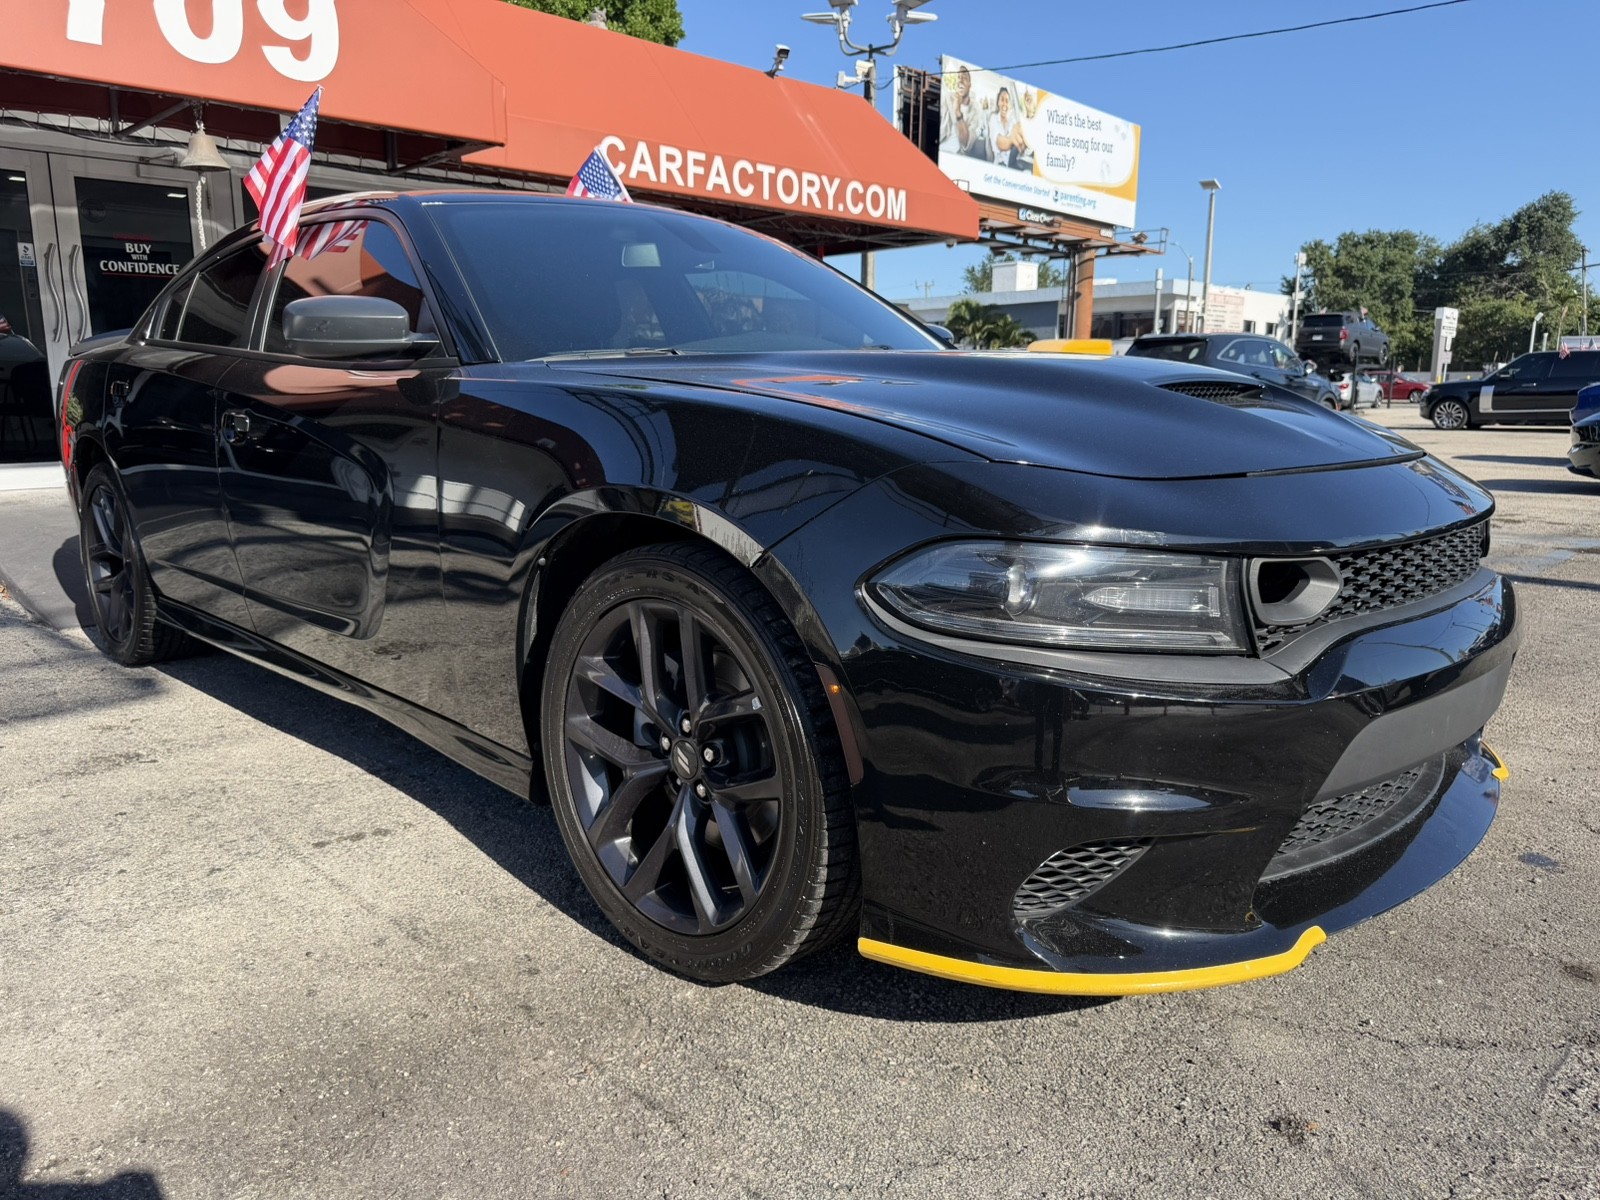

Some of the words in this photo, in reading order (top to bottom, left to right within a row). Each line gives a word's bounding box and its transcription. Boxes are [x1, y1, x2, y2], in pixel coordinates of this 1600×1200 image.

[1046, 109, 1073, 126] What's
[1074, 113, 1086, 129] the
[1086, 115, 1102, 131] best
[1046, 131, 1070, 148] theme
[1071, 137, 1089, 153] song
[1090, 137, 1101, 151] for
[1101, 142, 1113, 153] our
[1046, 152, 1076, 172] family?
[600, 135, 907, 222] CARFACTORY.COM
[984, 173, 993, 183] Get
[993, 174, 1001, 184] the
[1001, 178, 1033, 193] Conversation
[1033, 185, 1051, 197] Started
[1060, 191, 1097, 210] parenting.org
[125, 242, 152, 254] BUY
[131, 253, 148, 261] WITH
[100, 260, 180, 275] CONFIDENCE
